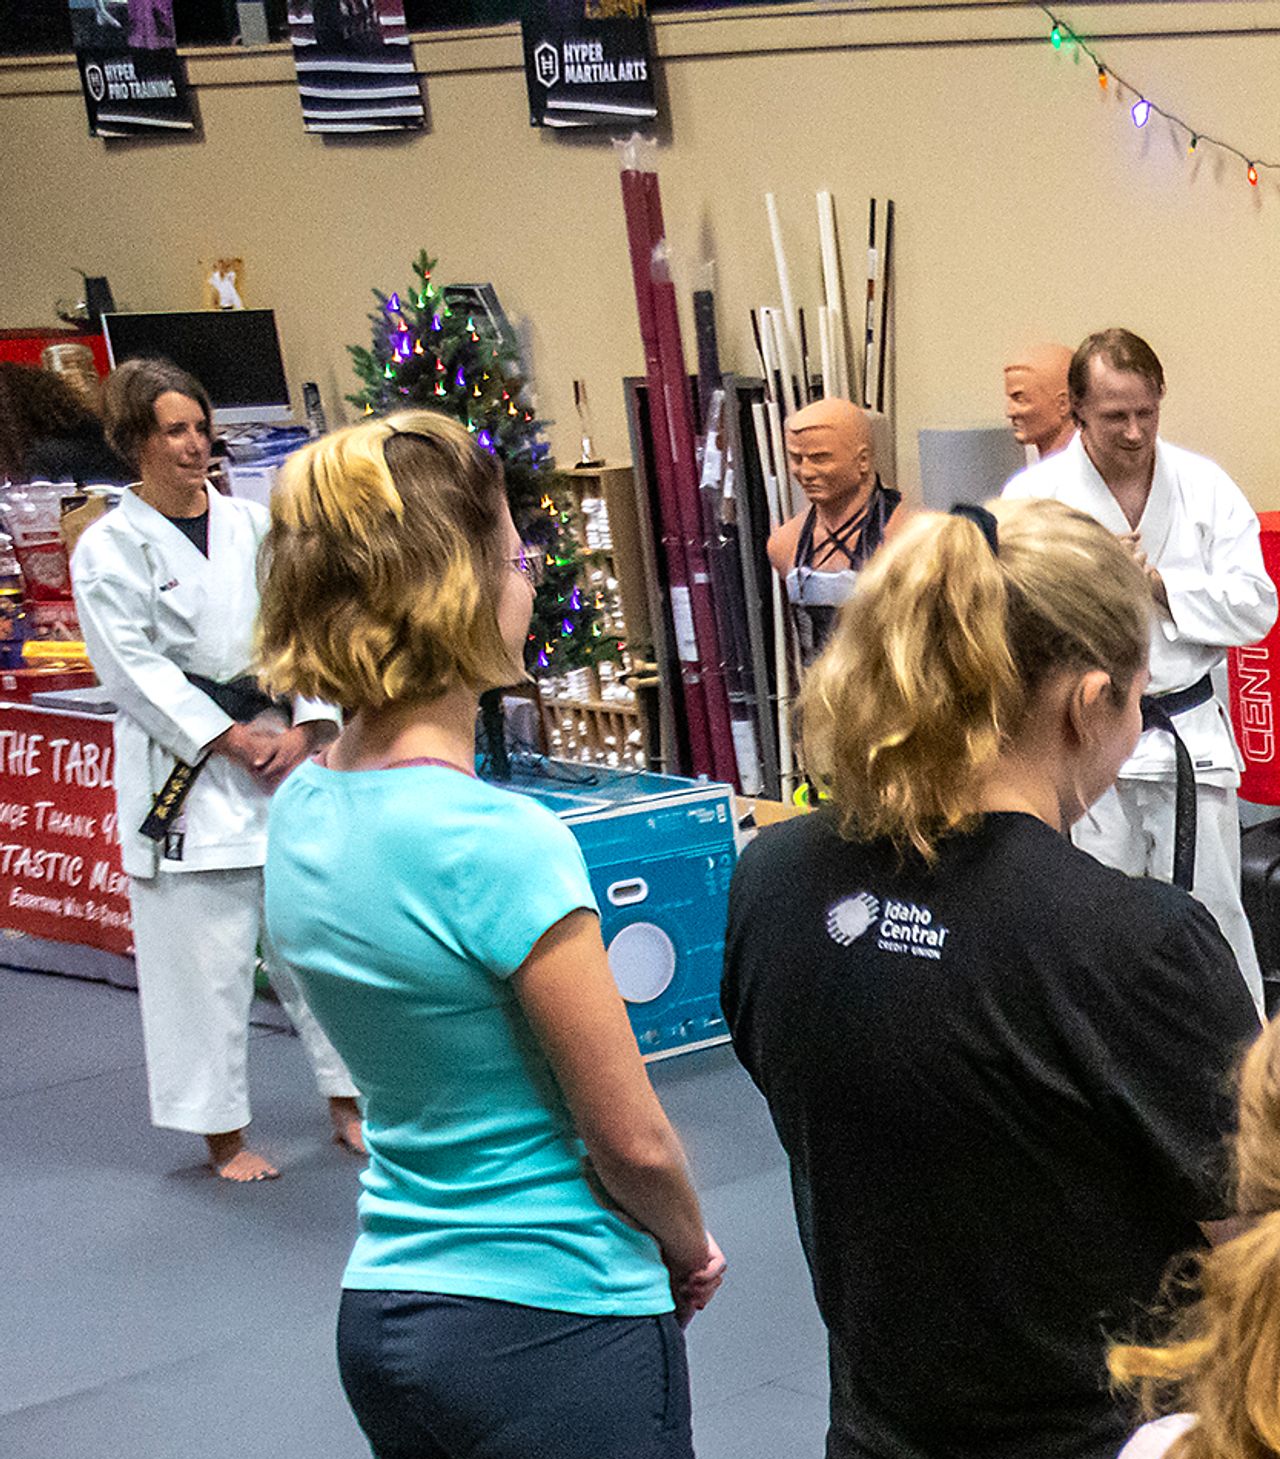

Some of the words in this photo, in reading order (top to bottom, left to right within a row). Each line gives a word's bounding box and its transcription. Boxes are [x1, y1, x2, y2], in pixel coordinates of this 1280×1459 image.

[563, 41, 604, 63] HYPER
[104, 63, 137, 81] HYPER
[565, 62, 617, 83] MARTIAL
[618, 59, 647, 81] ARTS
[109, 82, 129, 100] PRO
[129, 80, 177, 99] TRAINING
[1236, 646, 1275, 763] CENT
[49, 738, 116, 790] TABL
[884, 900, 933, 926] Idaho
[880, 919, 946, 947] Central
[877, 938, 908, 954] CREDIT
[910, 945, 942, 961] UNION
